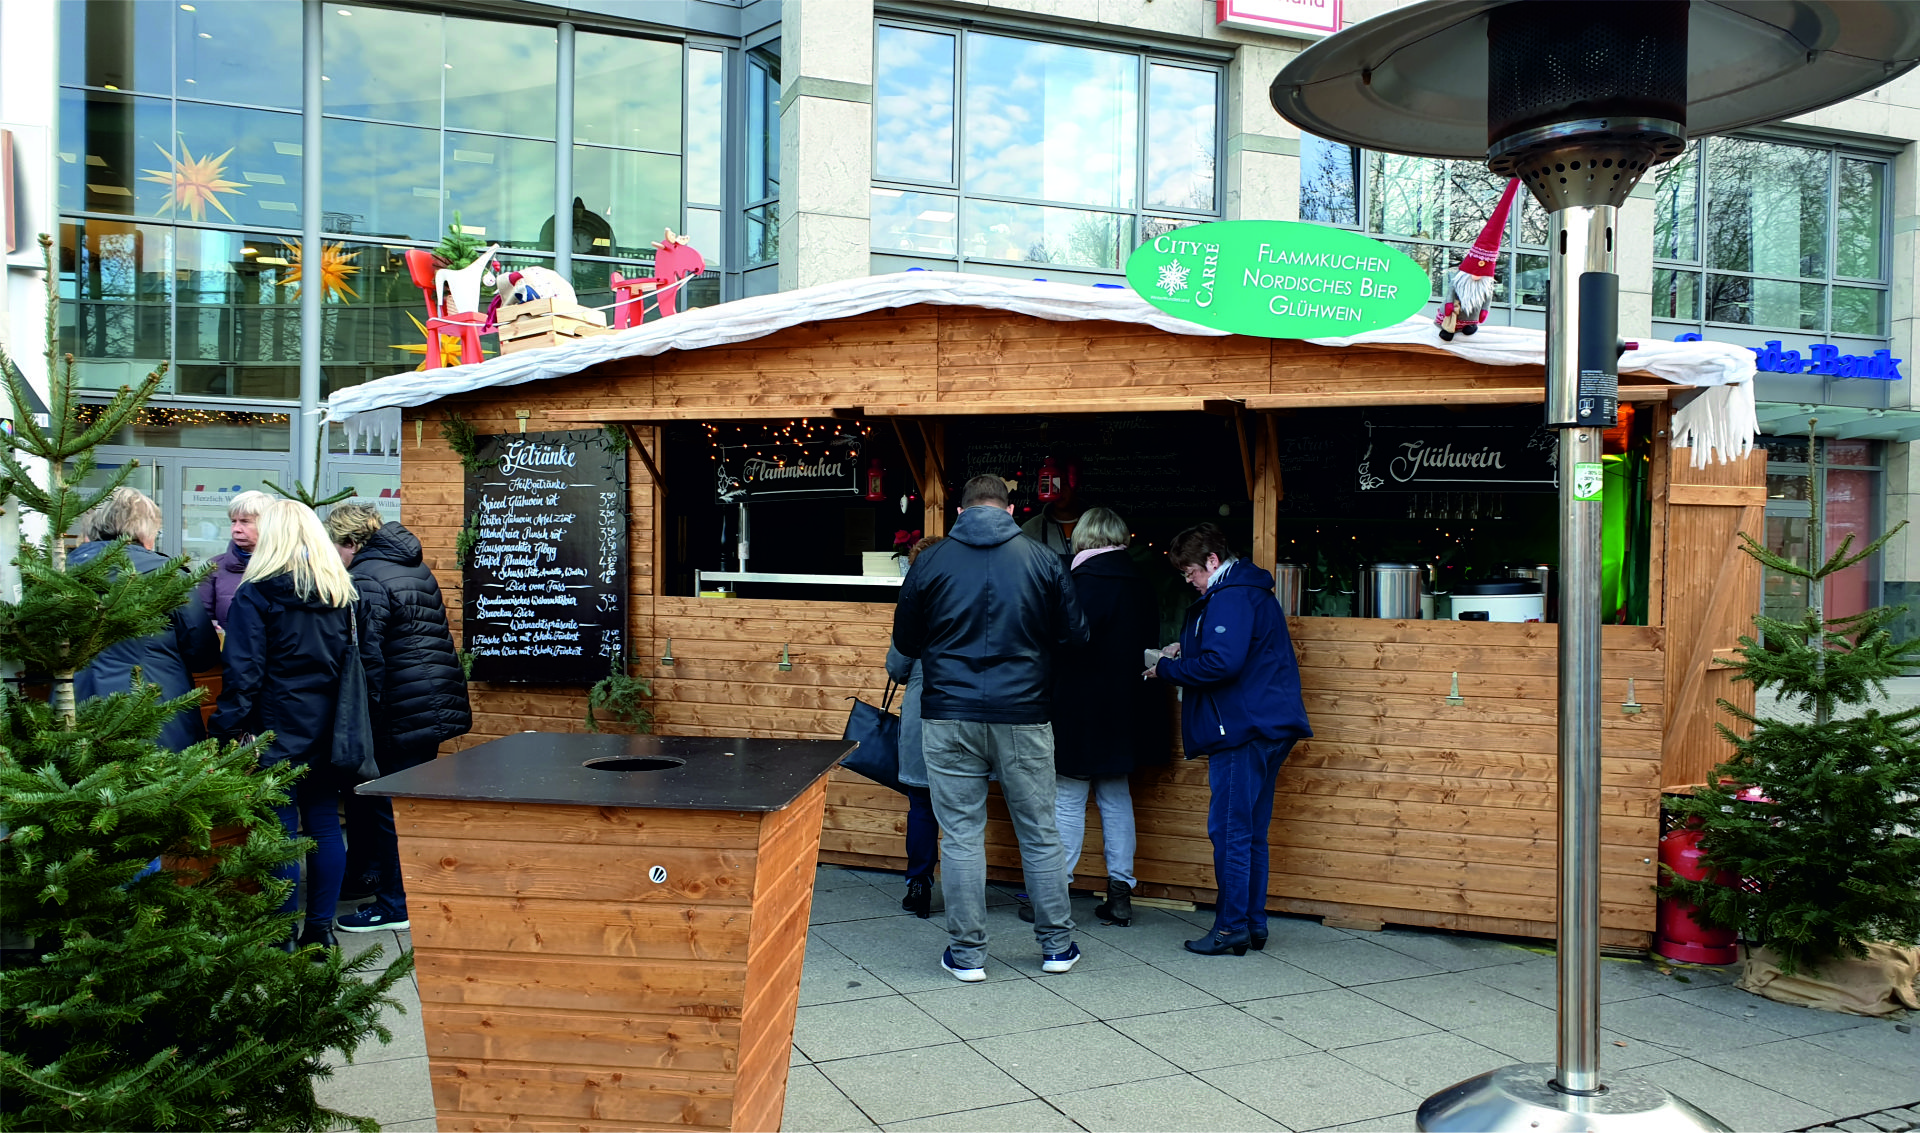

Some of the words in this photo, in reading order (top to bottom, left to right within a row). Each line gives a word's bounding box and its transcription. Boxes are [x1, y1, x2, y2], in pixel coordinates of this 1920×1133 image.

[1257, 244, 1390, 272] FLAMMKUCHEN
[1242, 268, 1352, 296] NORDISCHES
[1360, 278, 1398, 300] BIER
[1268, 295, 1362, 322] GLÜHWEIN
[498, 440, 577, 476] Getränke
[743, 454, 846, 484] Flammkuchen
[1390, 440, 1506, 482] Glühwein
[508, 494, 544, 514] Glühwein
[546, 493, 560, 506] rot
[550, 528, 568, 542] rot
[534, 542, 558, 562] Glögg
[506, 580, 528, 592] Bier
[528, 583, 546, 592] vom
[546, 580, 566, 593] Fass
